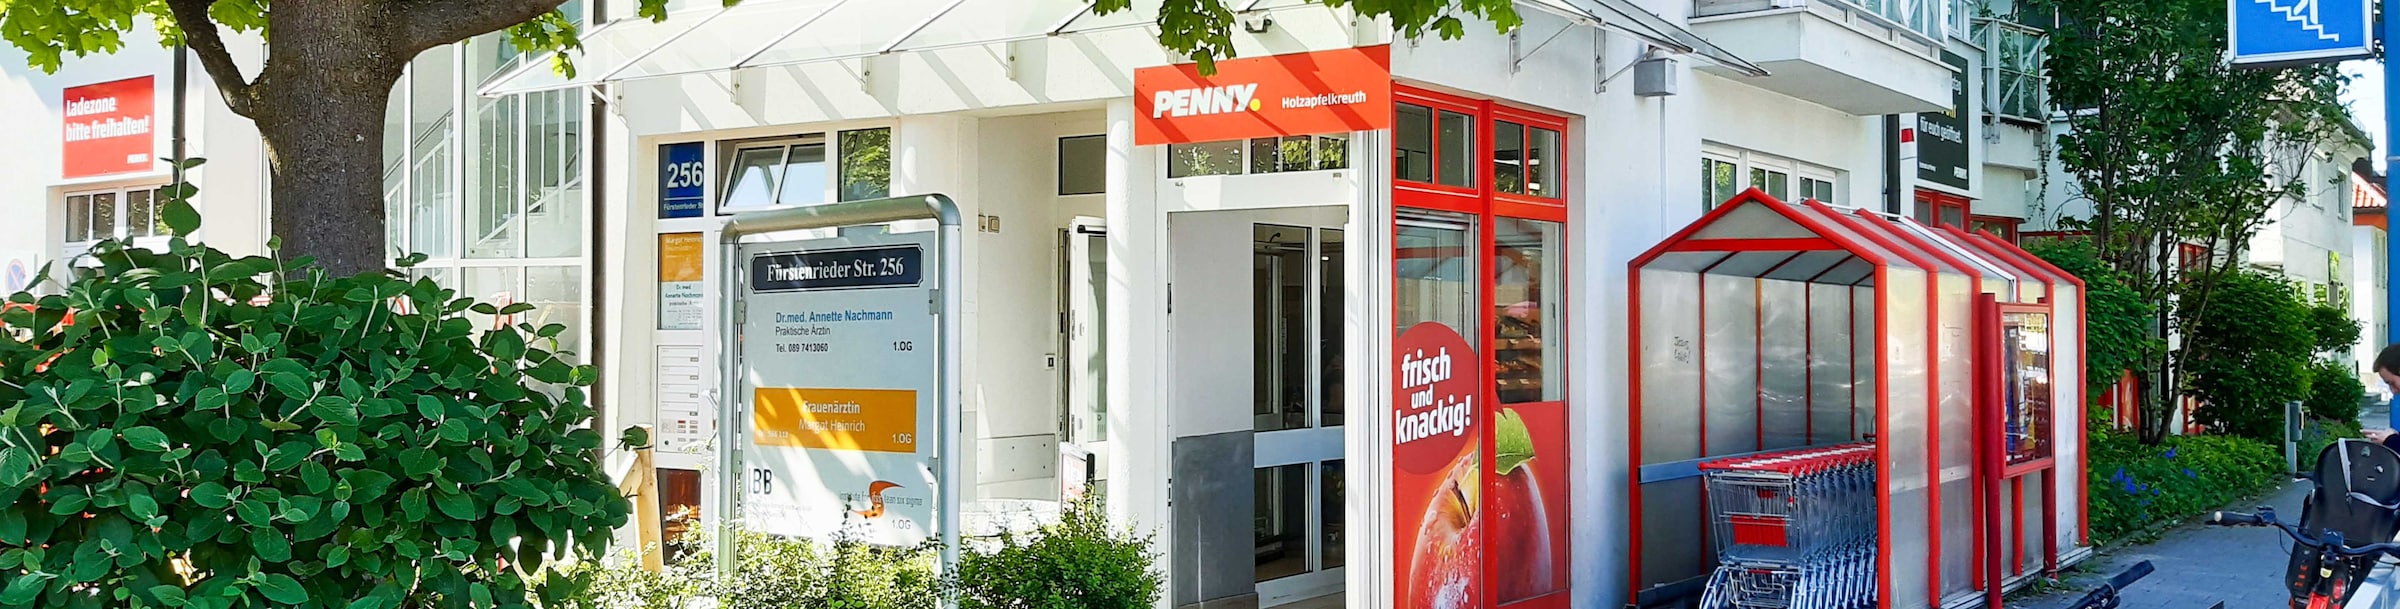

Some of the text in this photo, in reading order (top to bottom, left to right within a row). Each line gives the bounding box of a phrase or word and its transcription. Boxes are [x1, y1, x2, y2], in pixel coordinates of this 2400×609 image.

[66, 96, 117, 117] Ladezone
[1281, 90, 1367, 110] Holzapfelkreuth
[66, 115, 150, 142] bitte freihalten!
[667, 161, 704, 189] 256
[766, 256, 904, 282] Fürstenrieder Str. 256
[775, 310, 893, 324] Dr.med. Annette Nachmann
[775, 324, 831, 336] Praktische Ärztin
[776, 343, 787, 353] Tel.
[788, 343, 799, 353] 089
[893, 341, 913, 352] 1.OG
[1401, 346, 1451, 389] frisch
[1411, 383, 1434, 410] und
[802, 400, 861, 414] Frauenärztin
[798, 419, 866, 434] Margot Heinrich
[1395, 394, 1472, 445] knackig!
[892, 433, 912, 444] 1.OG
[747, 468, 772, 495] IBB
[891, 519, 911, 530] 1.OG
